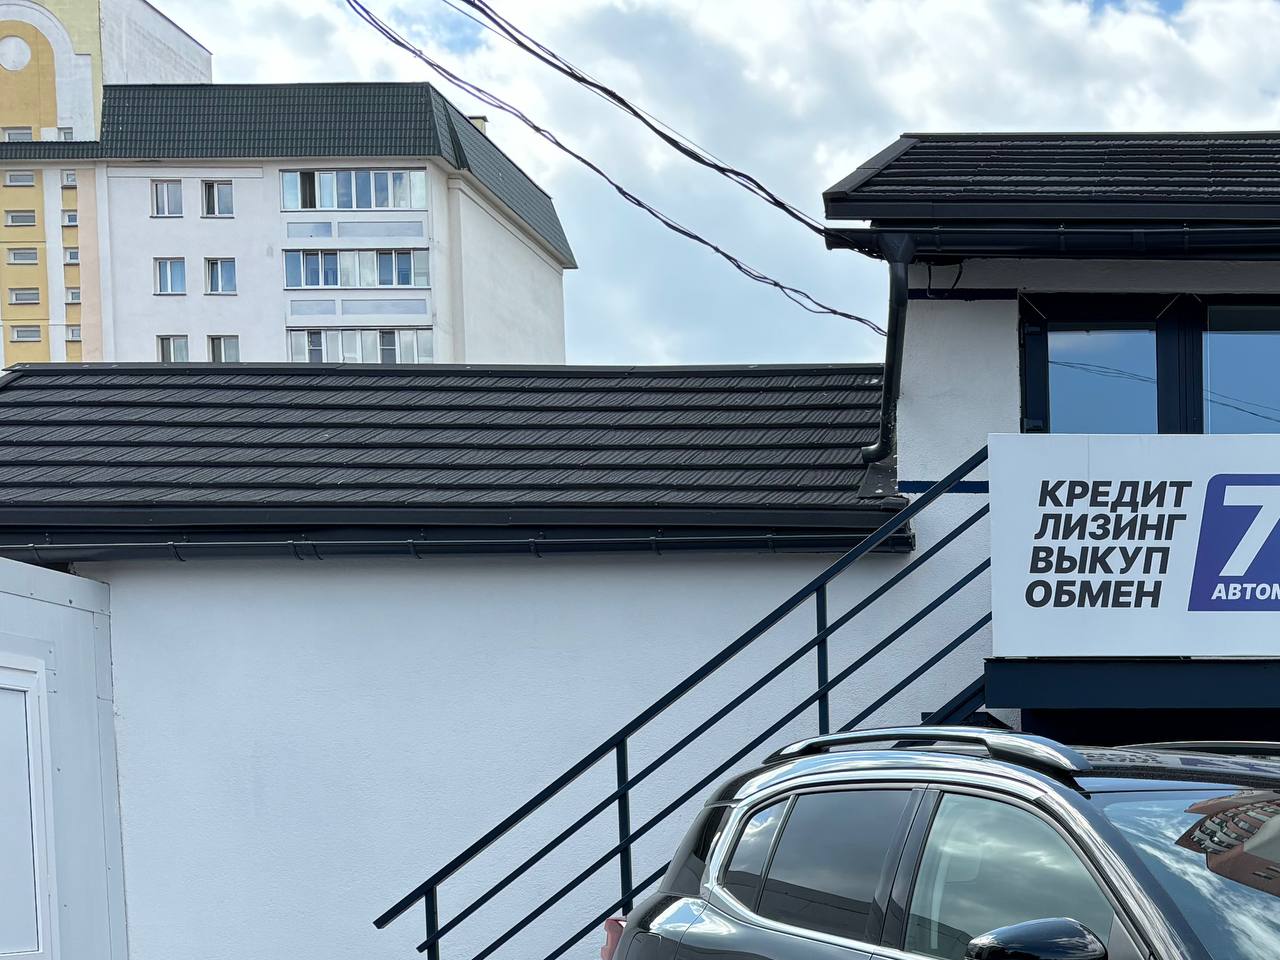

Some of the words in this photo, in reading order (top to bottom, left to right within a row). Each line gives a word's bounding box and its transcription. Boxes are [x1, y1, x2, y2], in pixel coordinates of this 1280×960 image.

[1038, 480, 1193, 514] КРЕДИТ
[1033, 513, 1188, 541] ЛИЗИНГ
[1029, 546, 1171, 575] ВЫКУП
[1024, 580, 1163, 608] ОБМЕН
